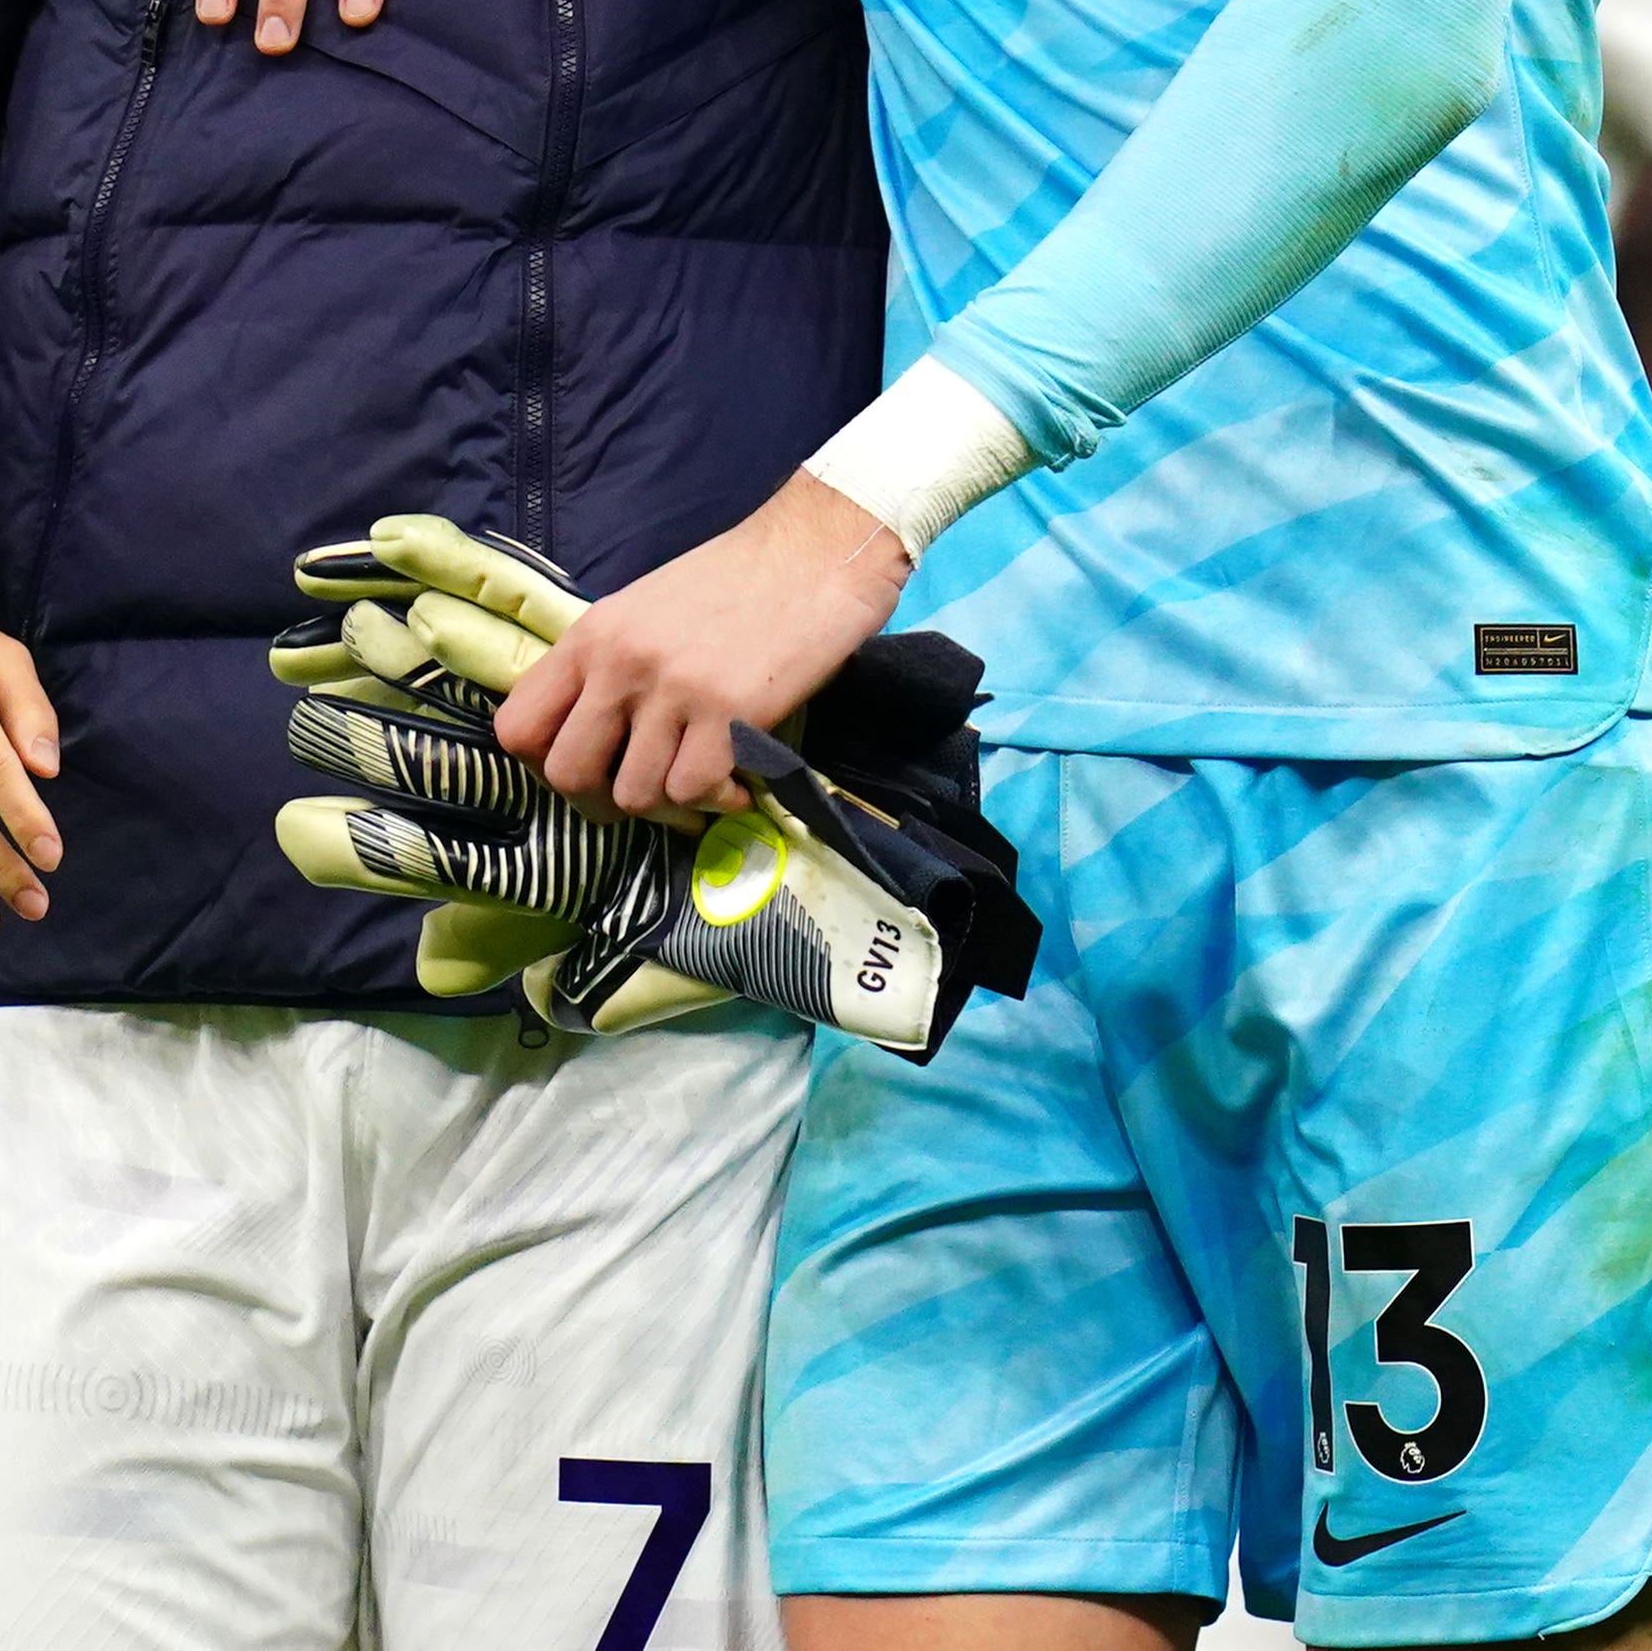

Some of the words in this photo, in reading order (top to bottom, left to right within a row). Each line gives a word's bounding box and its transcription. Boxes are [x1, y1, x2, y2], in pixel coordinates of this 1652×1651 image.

[857, 920, 902, 993] GV13
[1292, 1214, 1488, 1485] 13
[558, 1457, 712, 1651] 7
